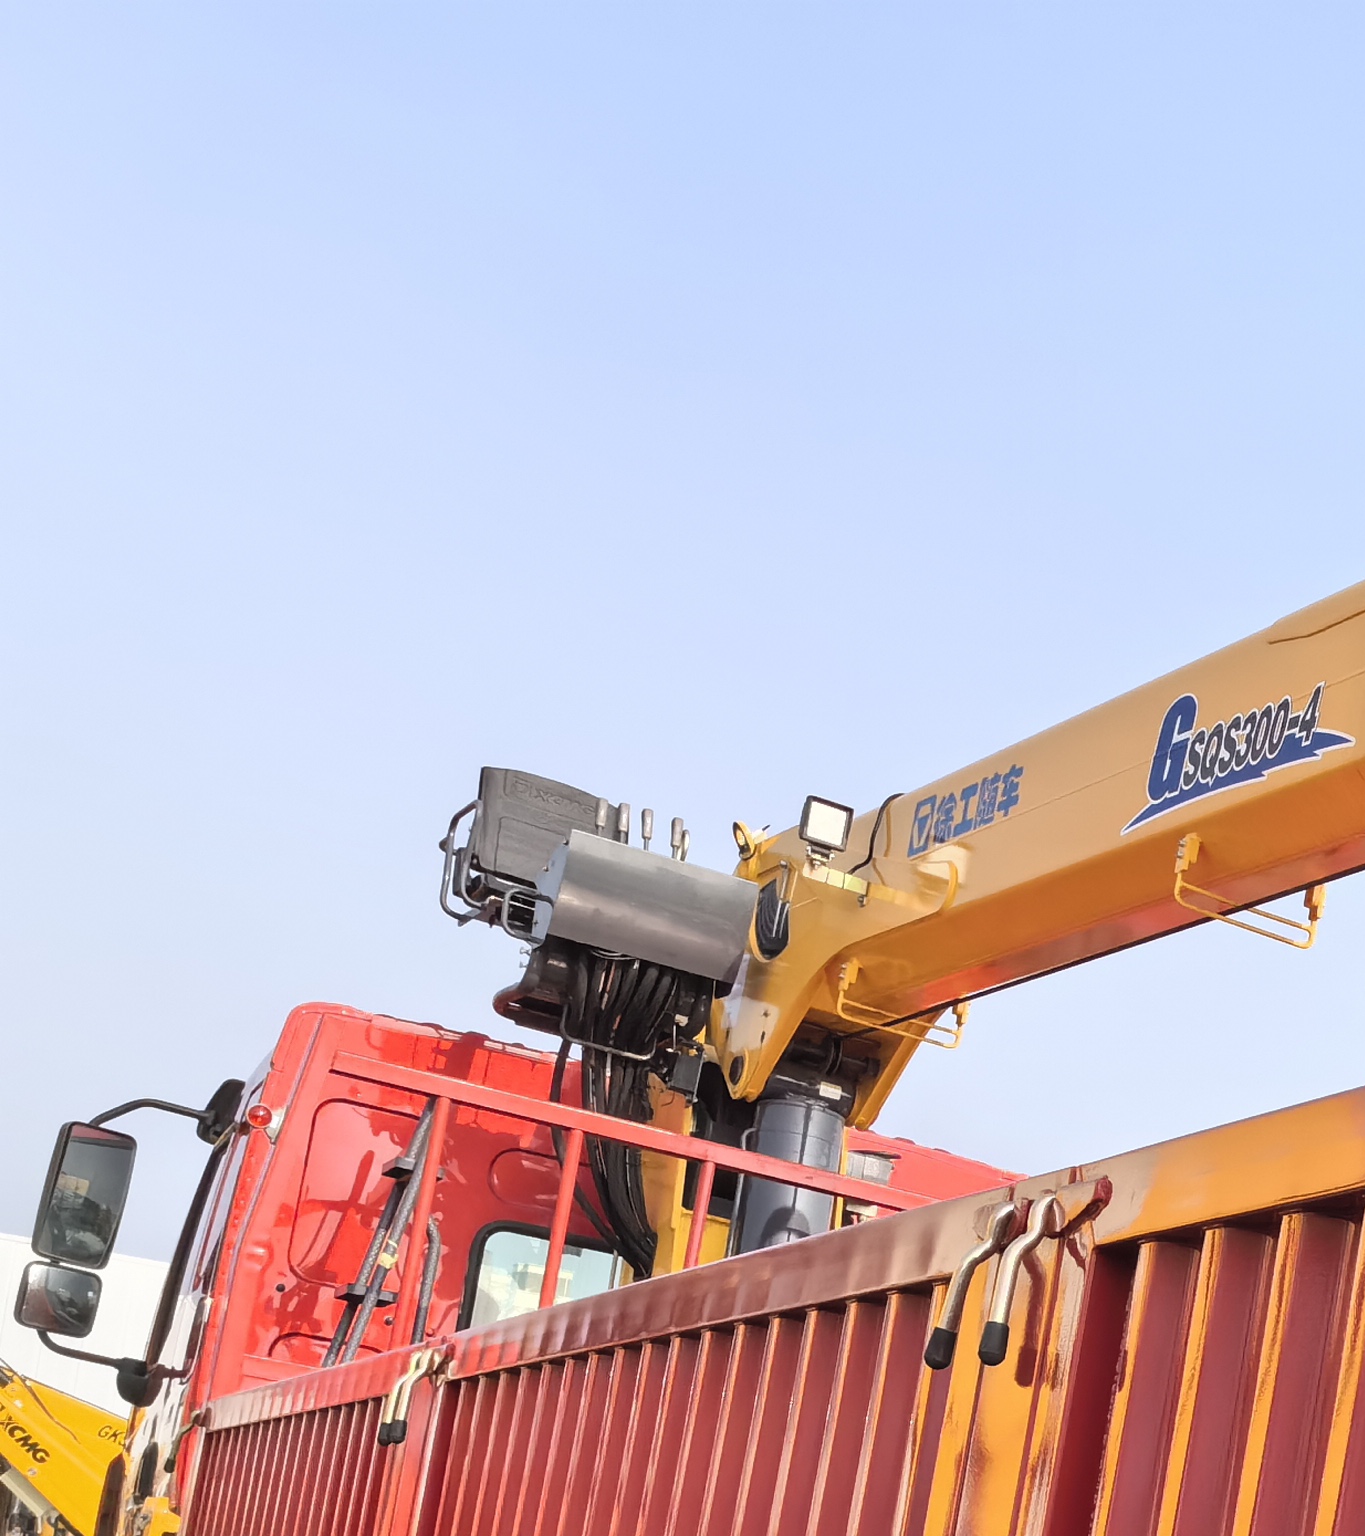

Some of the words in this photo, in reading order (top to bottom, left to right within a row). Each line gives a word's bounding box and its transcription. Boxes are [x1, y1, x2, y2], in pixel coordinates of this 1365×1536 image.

[1147, 680, 1325, 805] GSQS300-4
[933, 764, 1024, 844] 徐工随车
[0, 1412, 51, 1464] XCMG
[98, 1425, 126, 1449] GK
